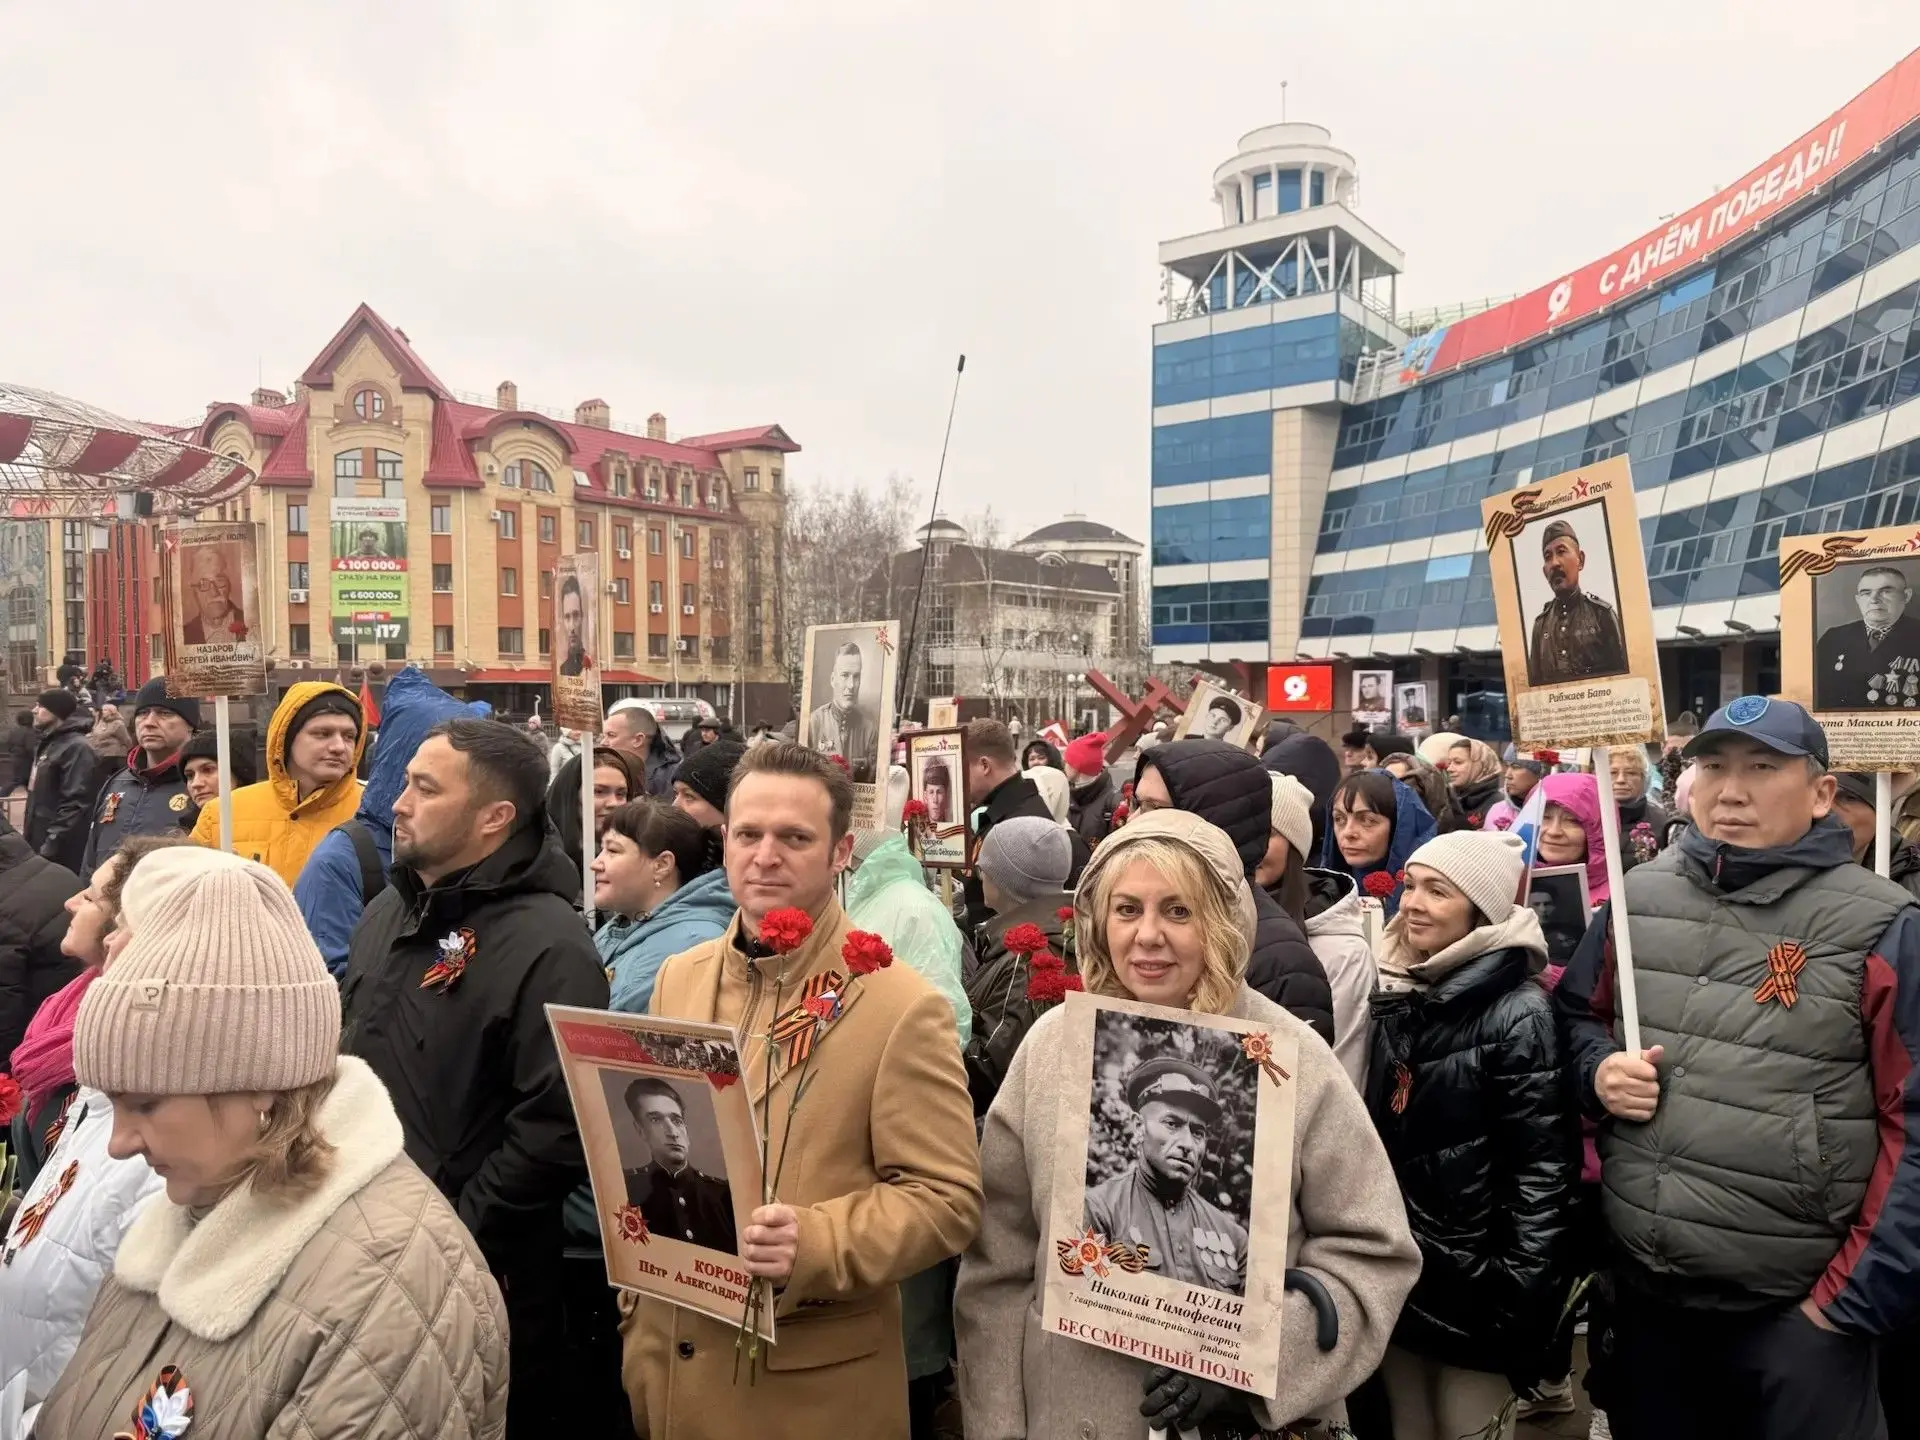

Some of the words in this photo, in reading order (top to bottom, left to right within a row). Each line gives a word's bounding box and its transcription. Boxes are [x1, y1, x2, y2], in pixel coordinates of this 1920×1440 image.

[1600, 265, 1618, 295] С
[1619, 217, 1702, 292] ДНЁМ
[1707, 121, 1847, 239] ПОБЕДЫ!
[1590, 481, 1612, 494] ПОЛК
[197, 645, 234, 654] НАЗАРОВ
[179, 656, 208, 665] СЕРГЕЙ
[211, 653, 254, 663] ИВАНОВИЧ
[1588, 688, 1612, 699] Бато
[1847, 718, 1893, 727] Максим
[1091, 1280, 1150, 1307] Николай
[1155, 1298, 1242, 1332] Тимофеевич
[1187, 1290, 1244, 1316] ЦУЛАЯ
[1068, 1292, 1074, 1300] 7
[1135, 1311, 1205, 1338] кавалерийский
[1207, 1332, 1241, 1349] корпус
[1058, 1316, 1195, 1370] БЕССМЕРТНЫЙ
[1200, 1360, 1254, 1388] ПОЛК
[1200, 1344, 1240, 1361] рядовой
